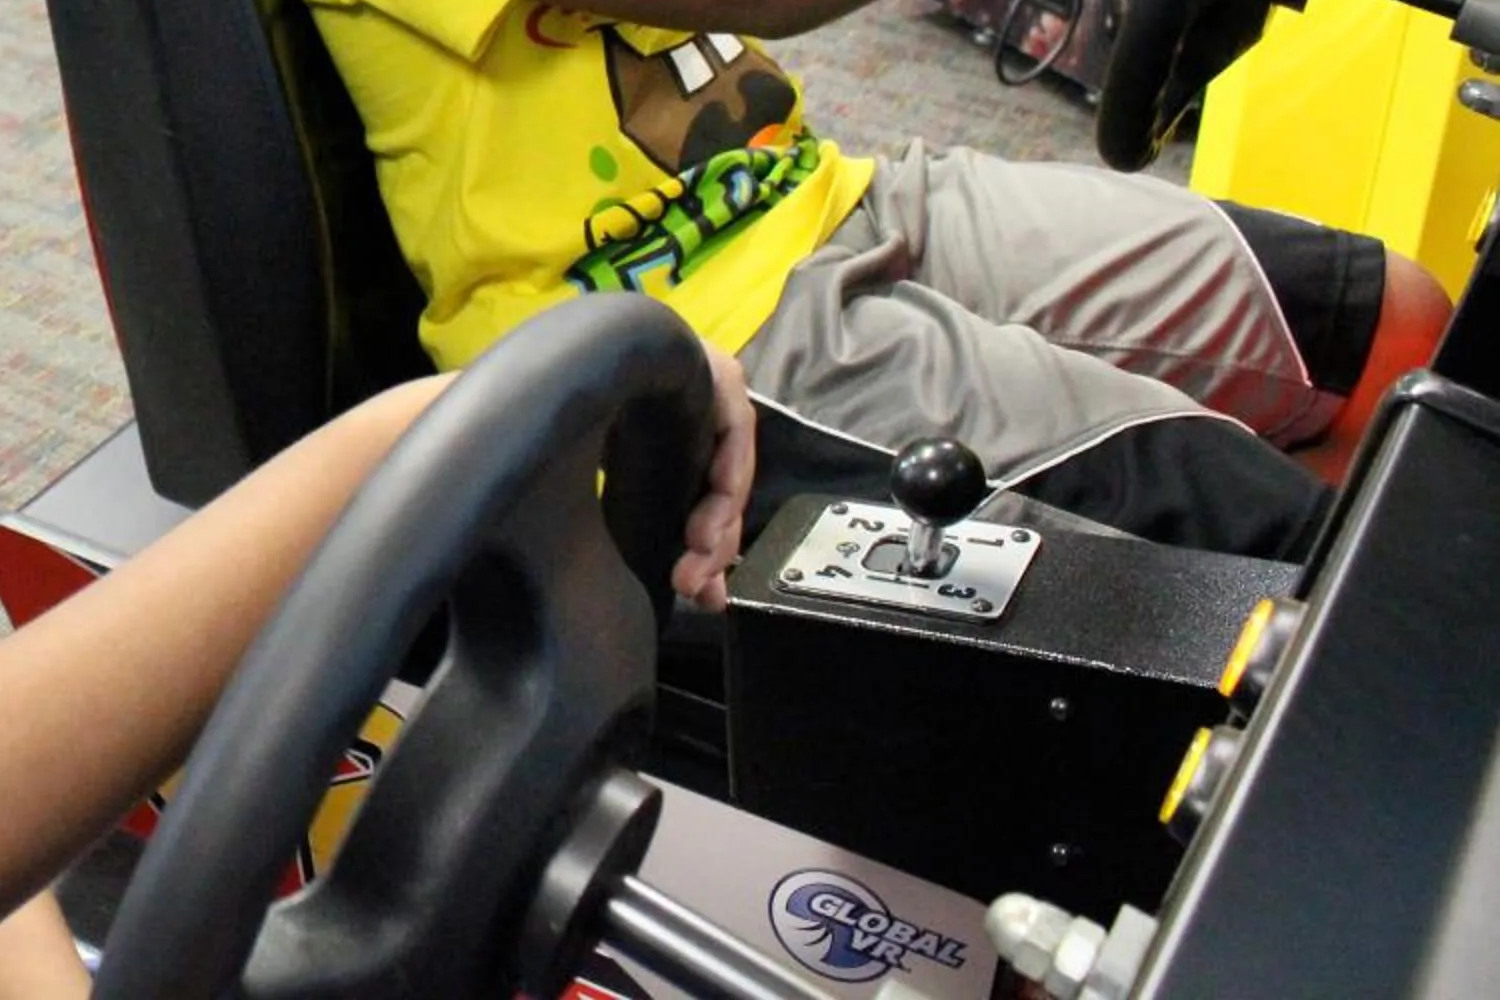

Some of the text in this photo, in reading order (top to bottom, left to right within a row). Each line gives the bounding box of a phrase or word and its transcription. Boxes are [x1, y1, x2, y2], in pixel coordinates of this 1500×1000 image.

[849, 517, 885, 532] 2
[966, 536, 1005, 548] 1
[815, 563, 853, 579] 4
[937, 583, 977, 599] 3
[810, 892, 966, 968] GLOBAL
[850, 929, 903, 966] VR
